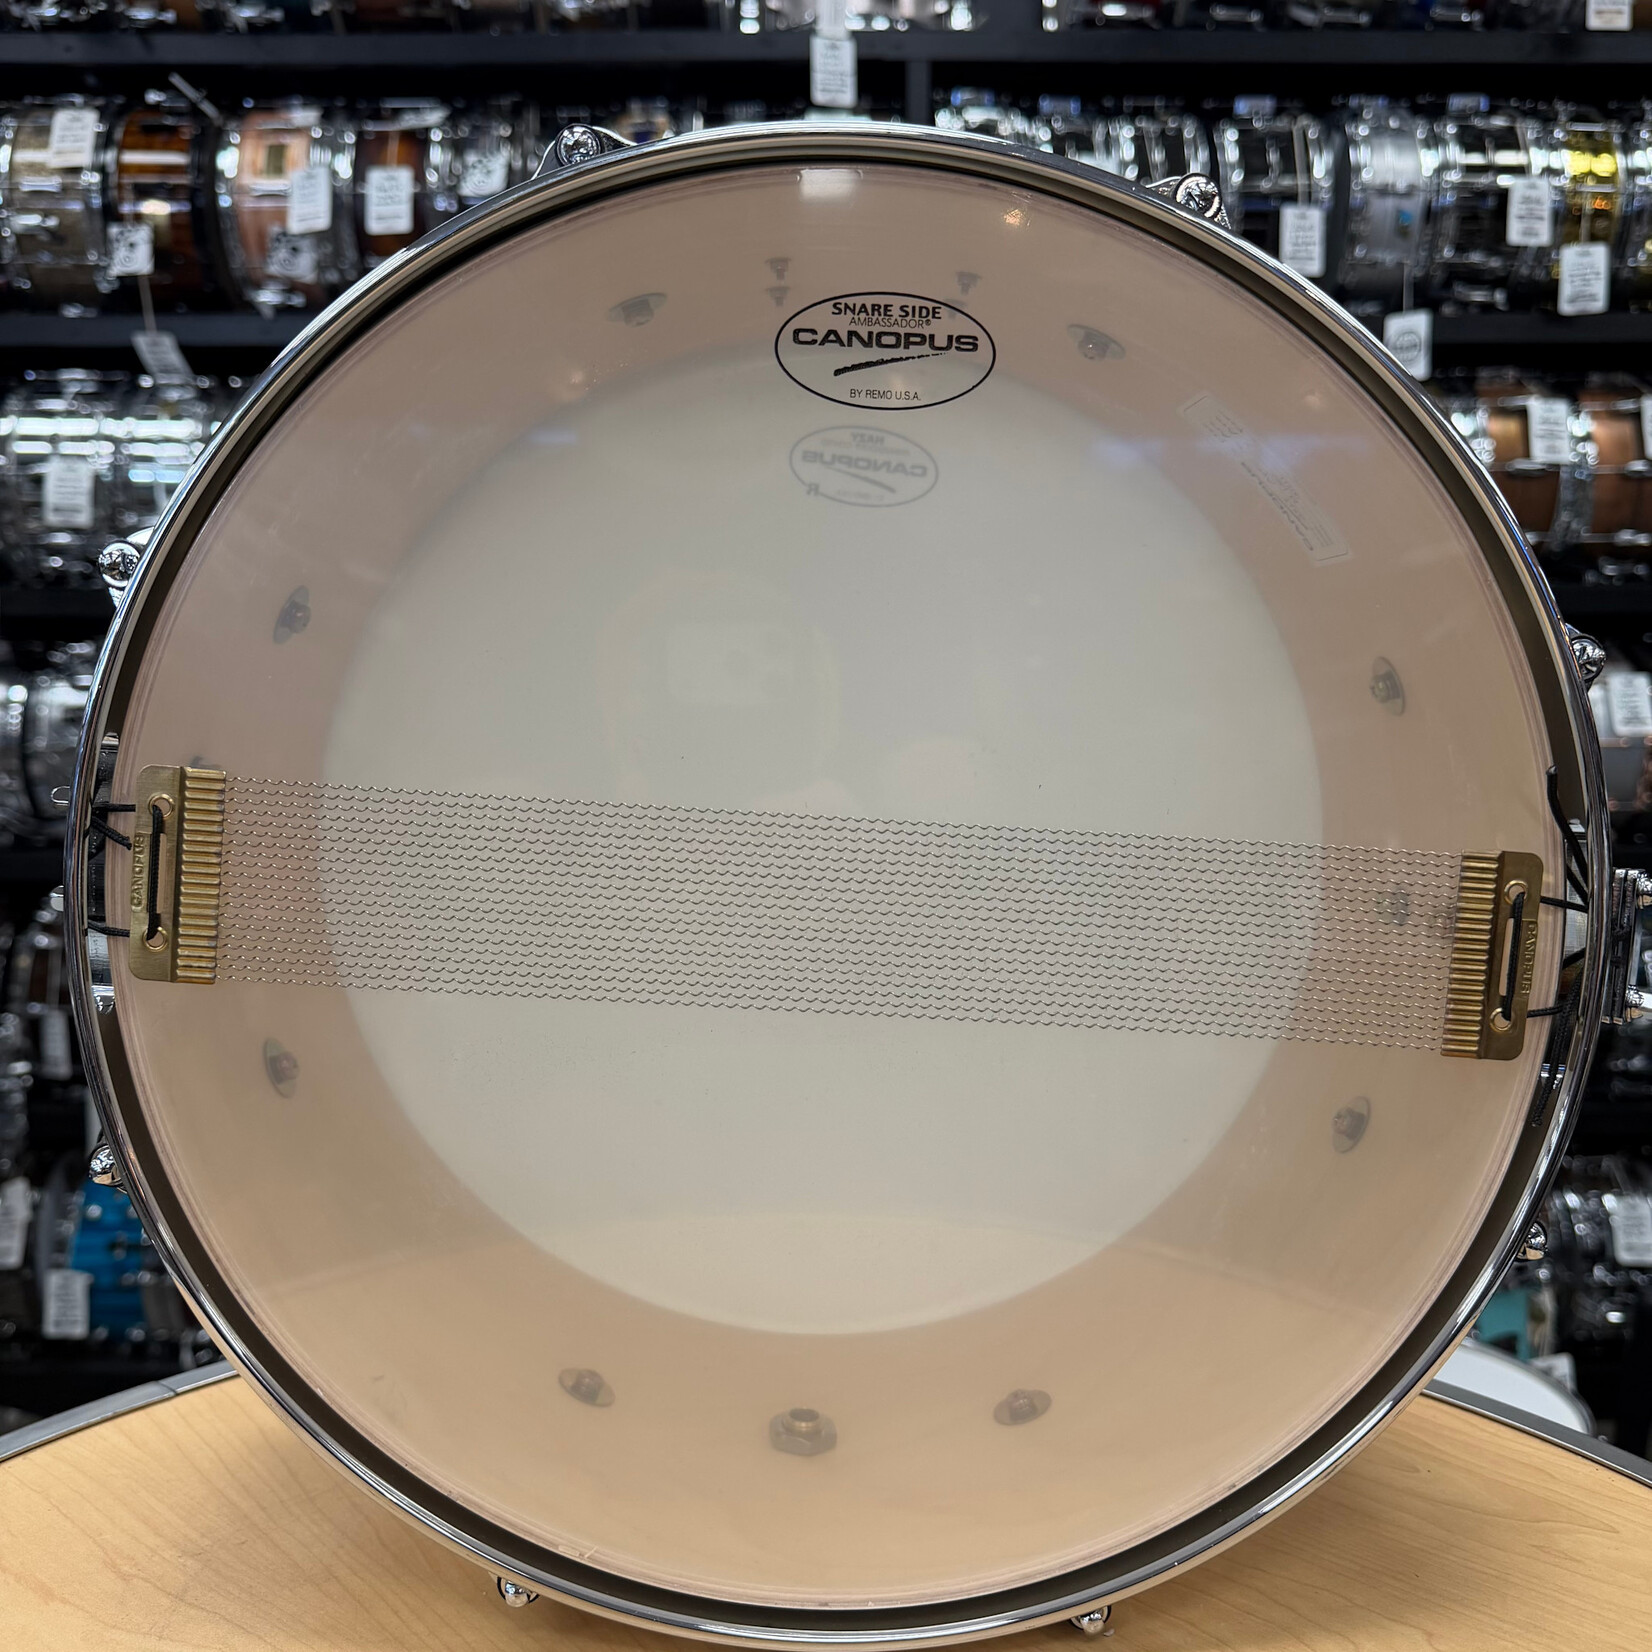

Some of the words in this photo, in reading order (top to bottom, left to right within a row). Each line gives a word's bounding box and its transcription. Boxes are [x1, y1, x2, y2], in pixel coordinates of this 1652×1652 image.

[831, 302, 894, 317] SNARE
[898, 304, 942, 320] SIDE
[792, 328, 979, 353] CANOPUS
[849, 389, 863, 399] BY
[865, 390, 893, 400] REMO
[895, 390, 921, 401] U.S.A.
[131, 835, 146, 909] CANOPUS
